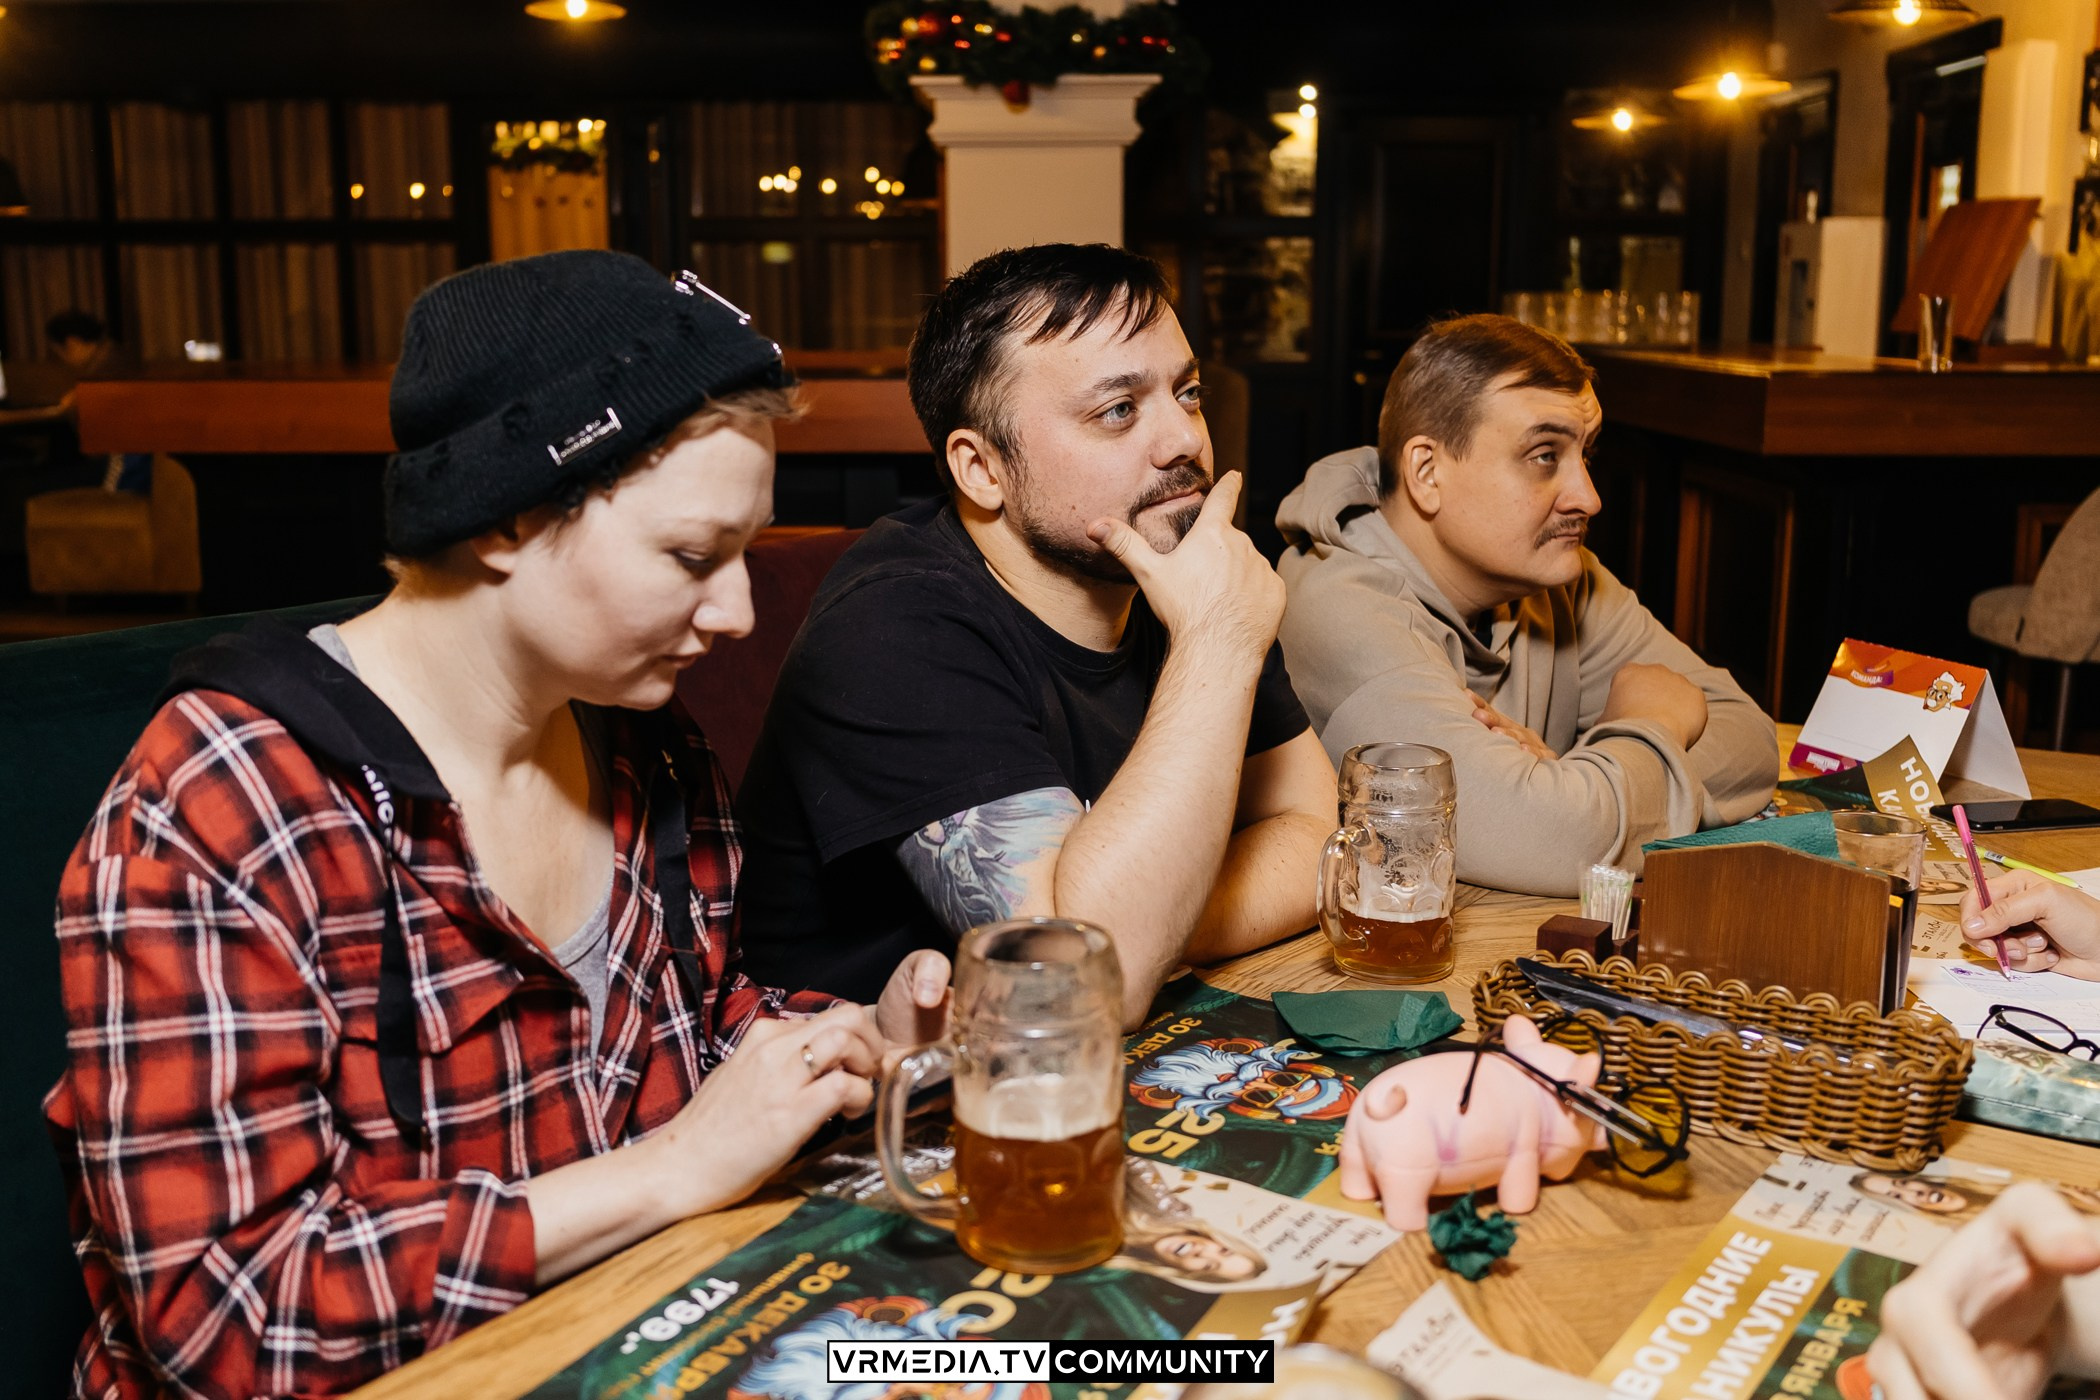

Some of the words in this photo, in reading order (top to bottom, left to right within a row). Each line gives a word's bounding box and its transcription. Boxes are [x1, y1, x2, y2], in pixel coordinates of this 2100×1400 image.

[1168, 1018, 1203, 1034] 30
[1128, 1108, 1226, 1159] 25
[798, 1261, 852, 1295] 30
[1606, 1231, 1773, 1400] ВОГОДНИЕ
[1680, 1264, 1821, 1400] НИКУЛЫ
[1779, 1296, 1869, 1397] ЯНВАРЯ
